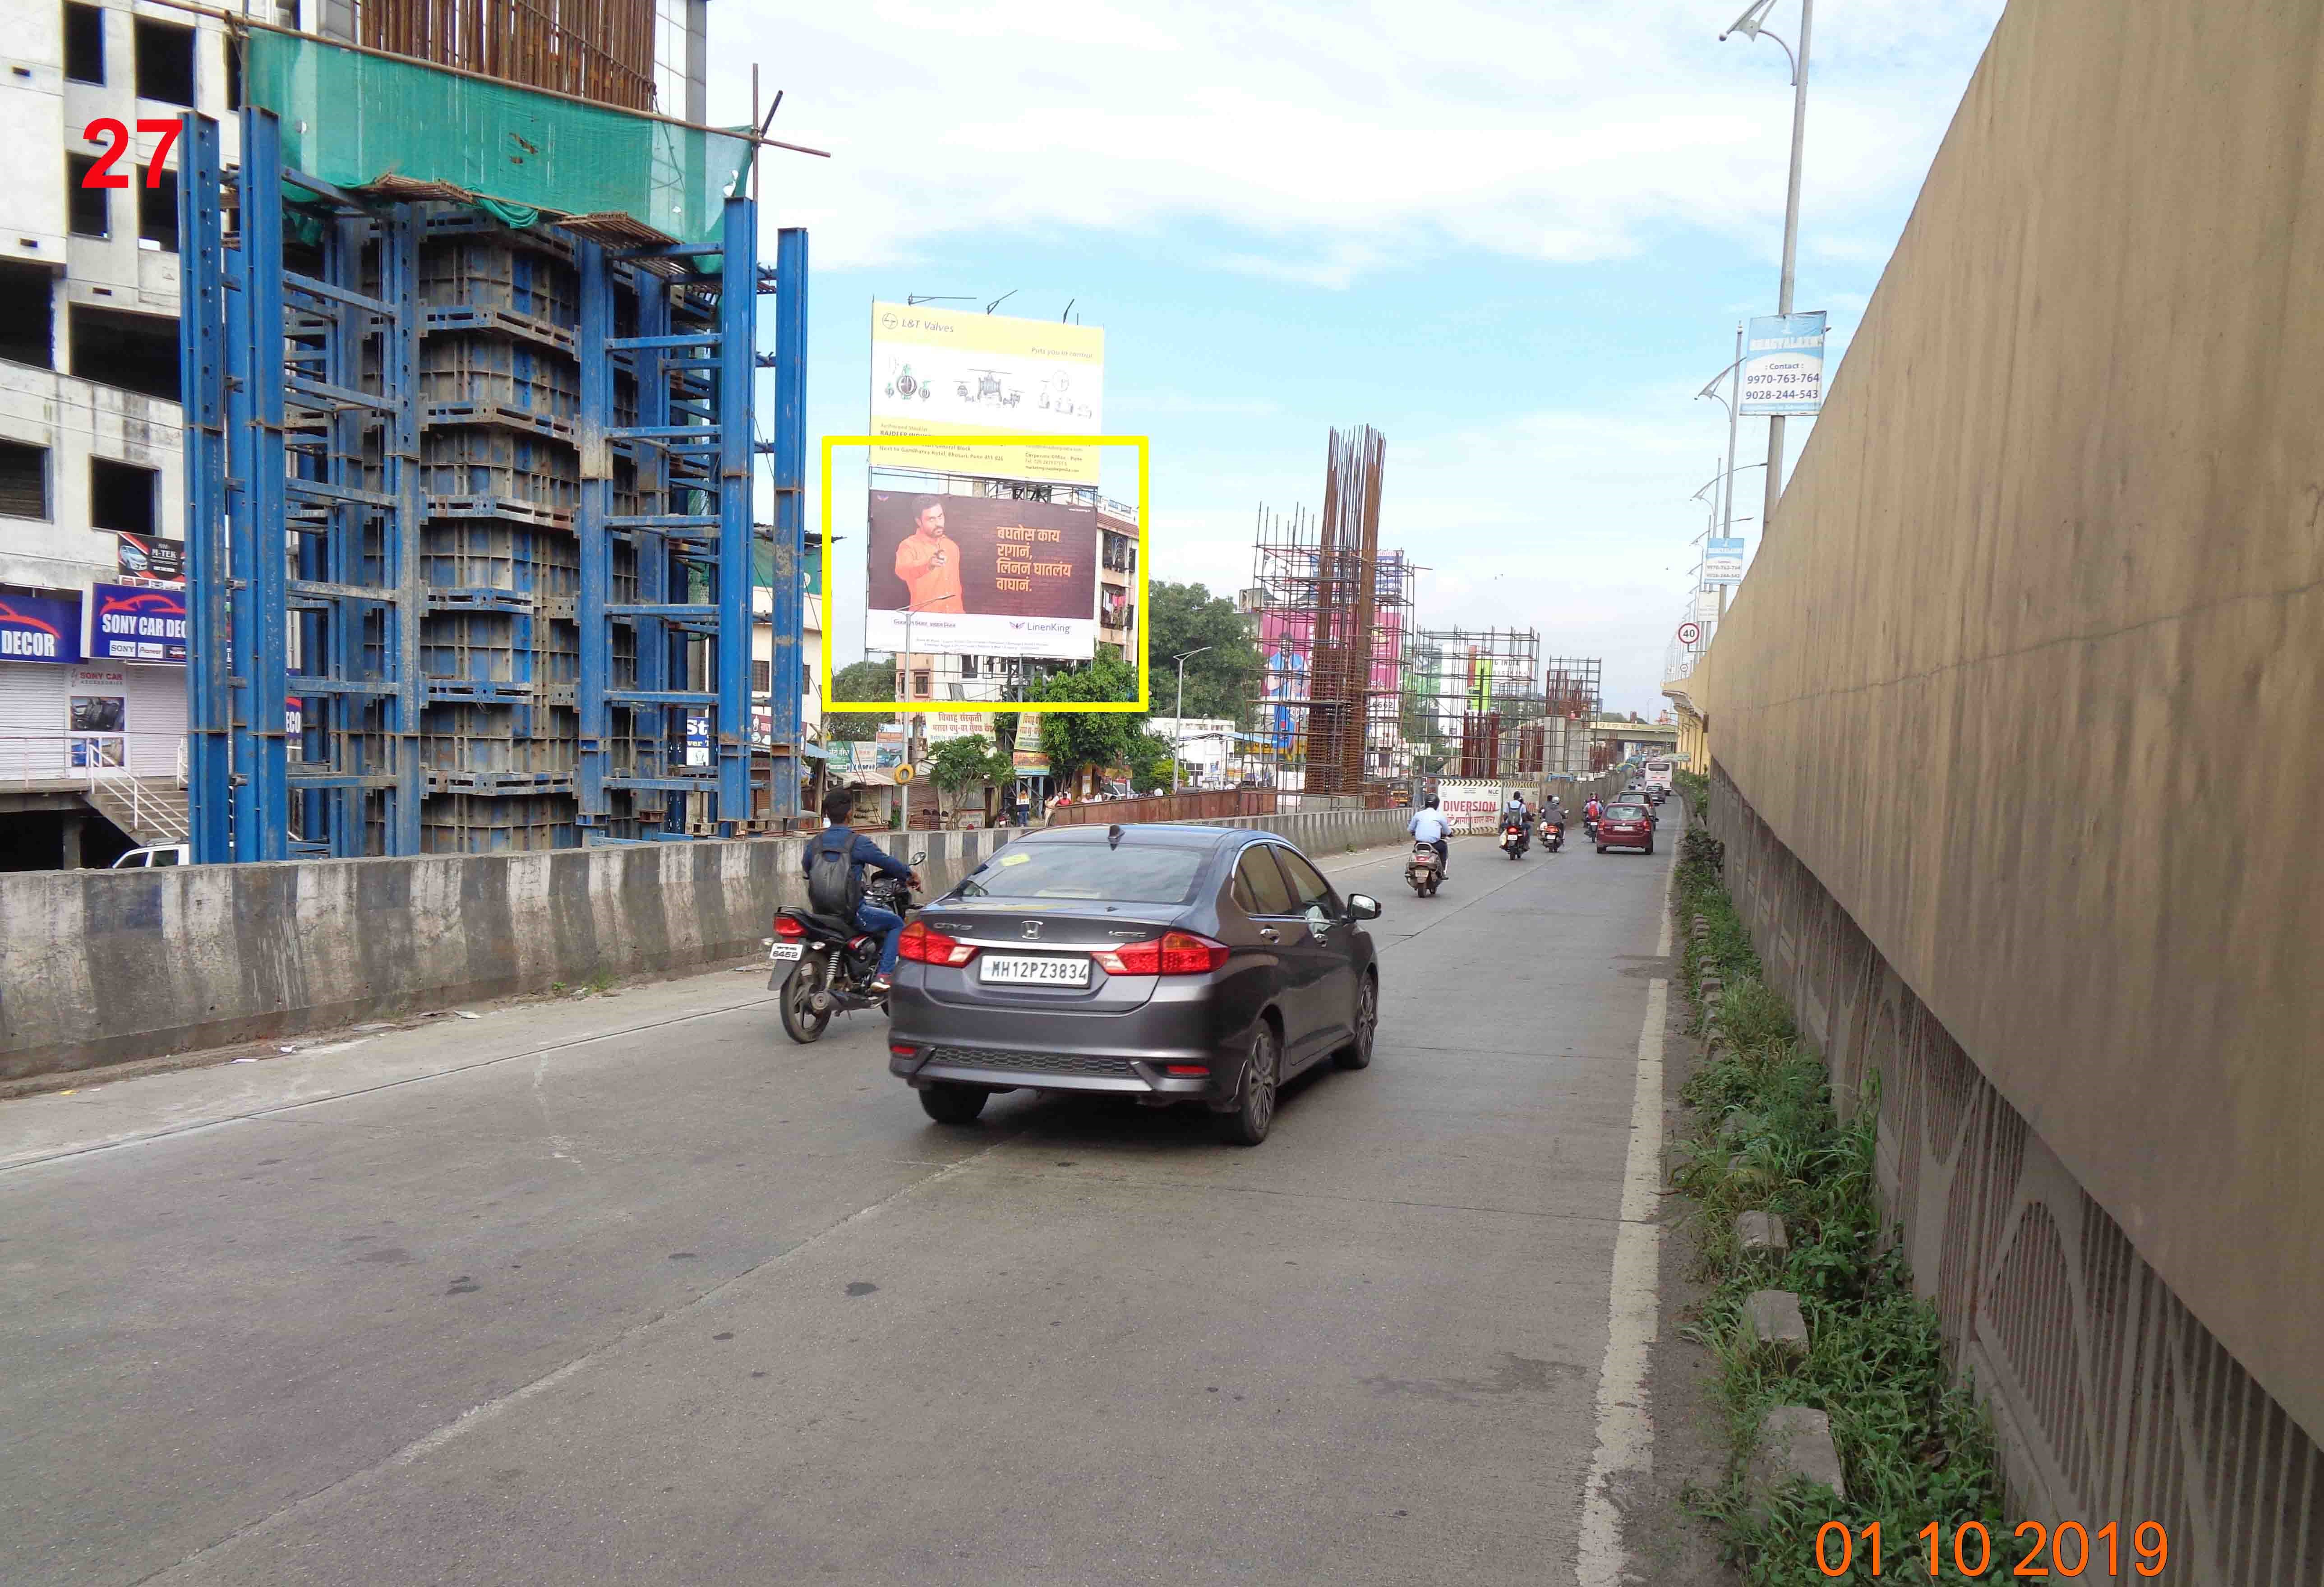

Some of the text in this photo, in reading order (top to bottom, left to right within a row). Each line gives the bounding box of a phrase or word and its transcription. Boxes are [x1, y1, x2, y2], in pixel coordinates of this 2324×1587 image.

[902, 318, 953, 332] L&T Valves
[1747, 373, 1820, 384] 9970-763-764
[1745, 389, 1818, 400] 9028-244-543
[996, 524, 1061, 543] बघतोस काय
[996, 557, 1072, 577] लिनन घातलंय
[996, 576, 1033, 592] वाघानं.
[102, 613, 187, 639] SONY CAR DEC
[1027, 622, 1070, 635] LinenKing
[1683, 629, 1695, 637] 40
[1, 630, 55, 657] DECOR
[938, 712, 958, 723] विवाह
[1443, 801, 1496, 812] DIVERSION
[773, 950, 798, 959] 6452
[992, 961, 1088, 981] MH12PZ3834
